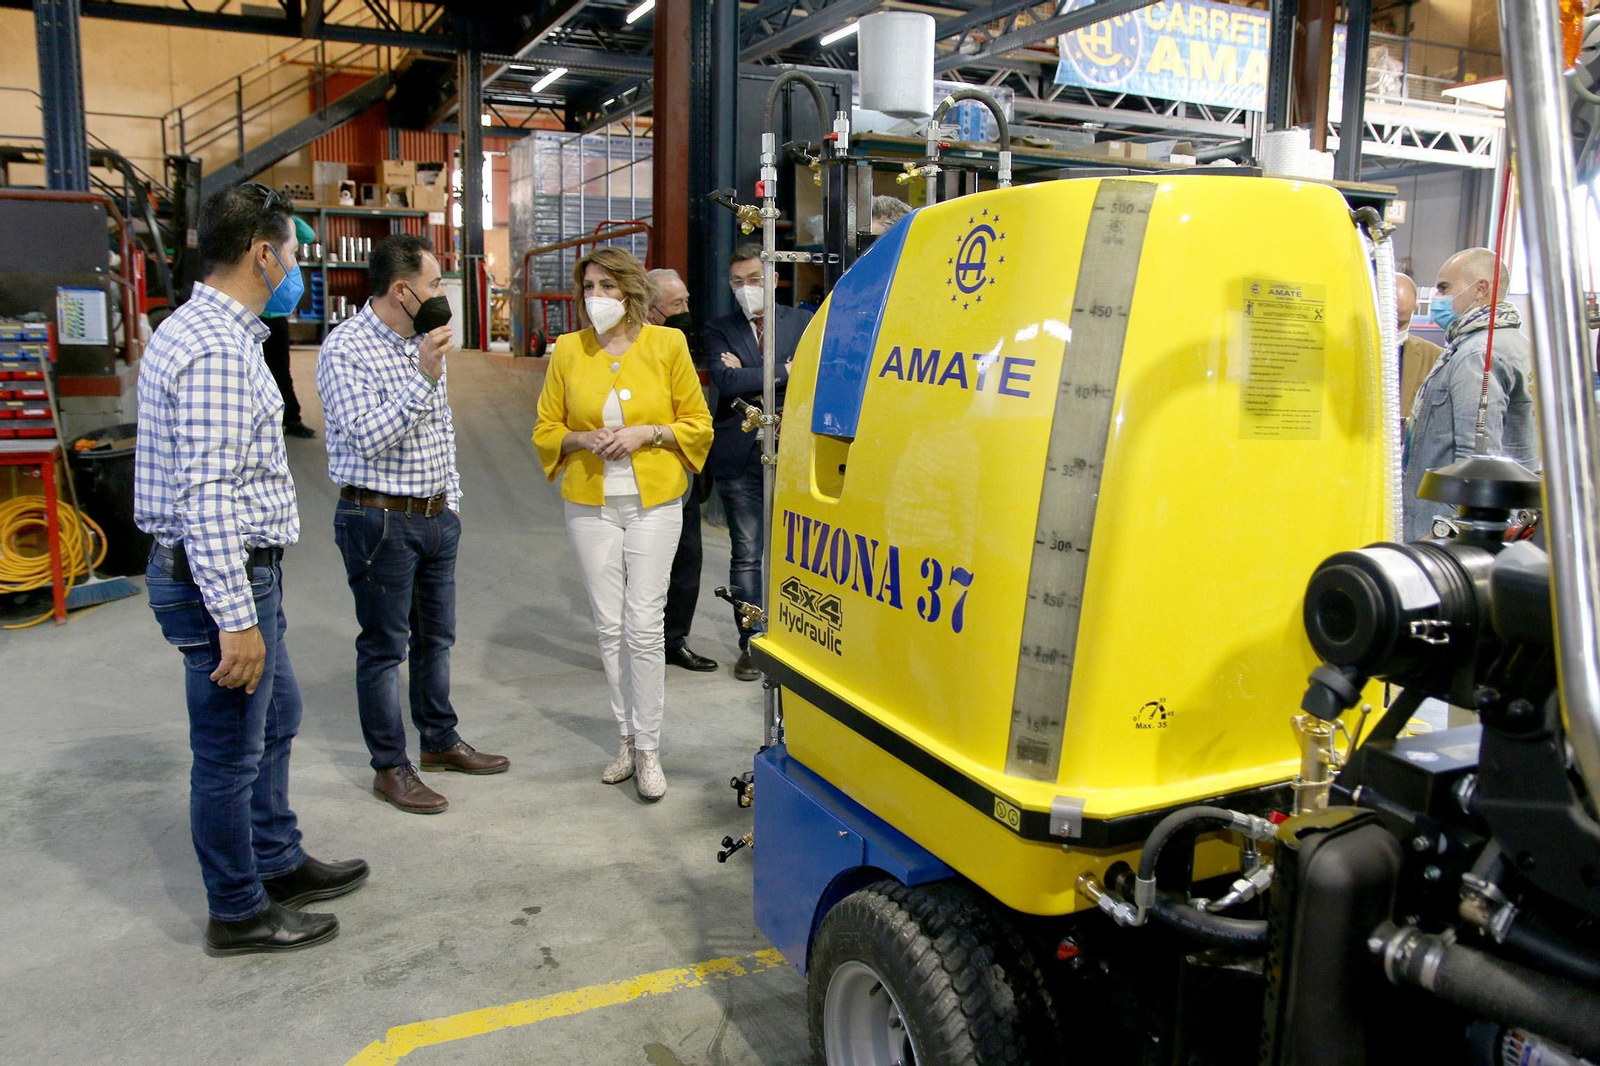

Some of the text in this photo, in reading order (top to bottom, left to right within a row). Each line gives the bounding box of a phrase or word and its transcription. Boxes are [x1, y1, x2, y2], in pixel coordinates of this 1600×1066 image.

[1268, 289, 1302, 298] AMATE
[1089, 305, 1113, 318] 450
[878, 345, 1037, 399] AMATE
[1050, 539, 1072, 552] 300
[783, 509, 975, 634] TIZONA 37
[779, 602, 843, 657] Hydraulic
